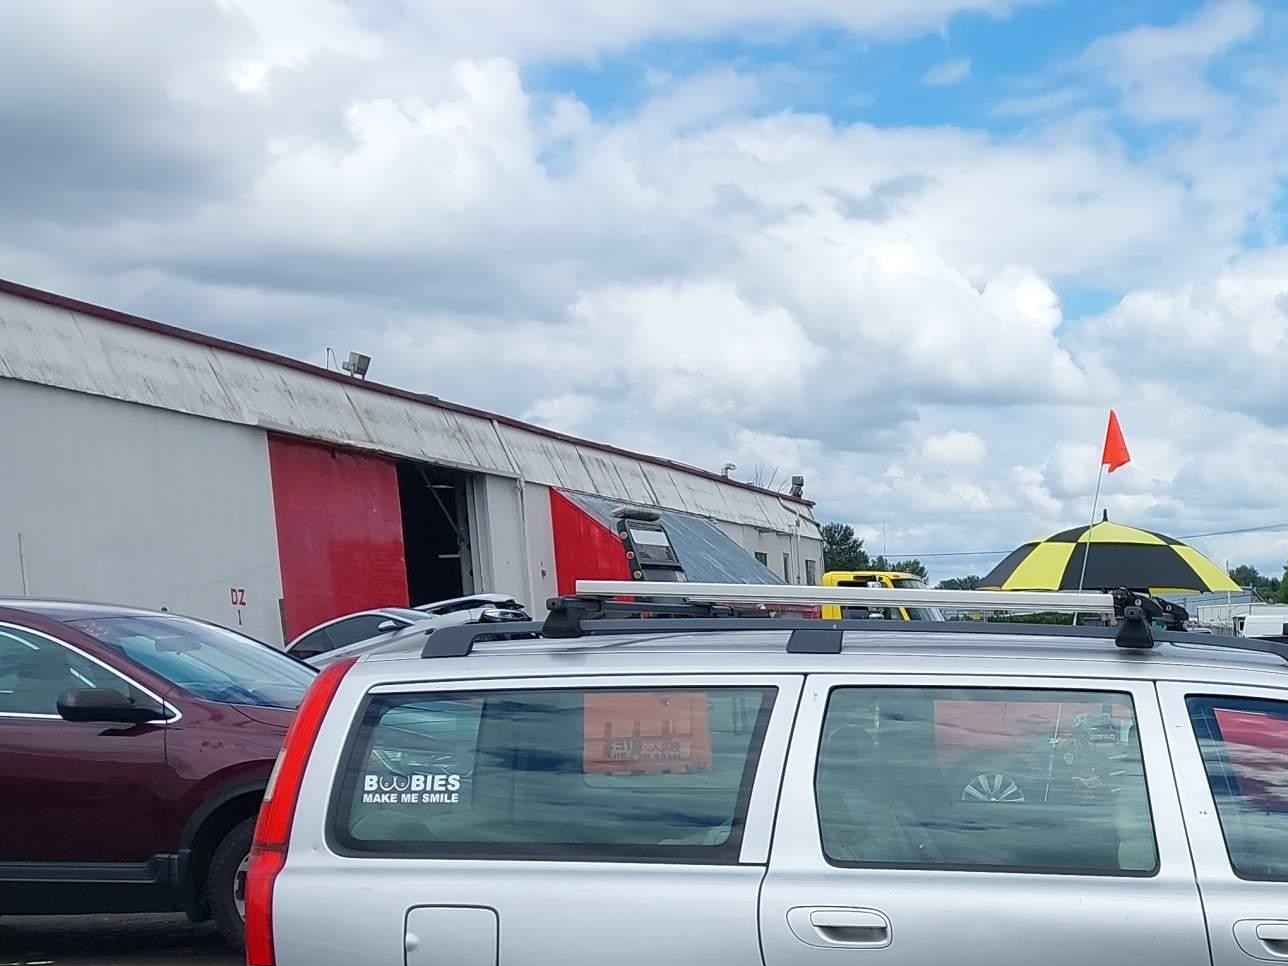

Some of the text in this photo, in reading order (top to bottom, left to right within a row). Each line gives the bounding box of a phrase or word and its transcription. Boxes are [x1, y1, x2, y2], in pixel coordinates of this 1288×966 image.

[362, 793, 459, 803] MAKE ME SMILE
